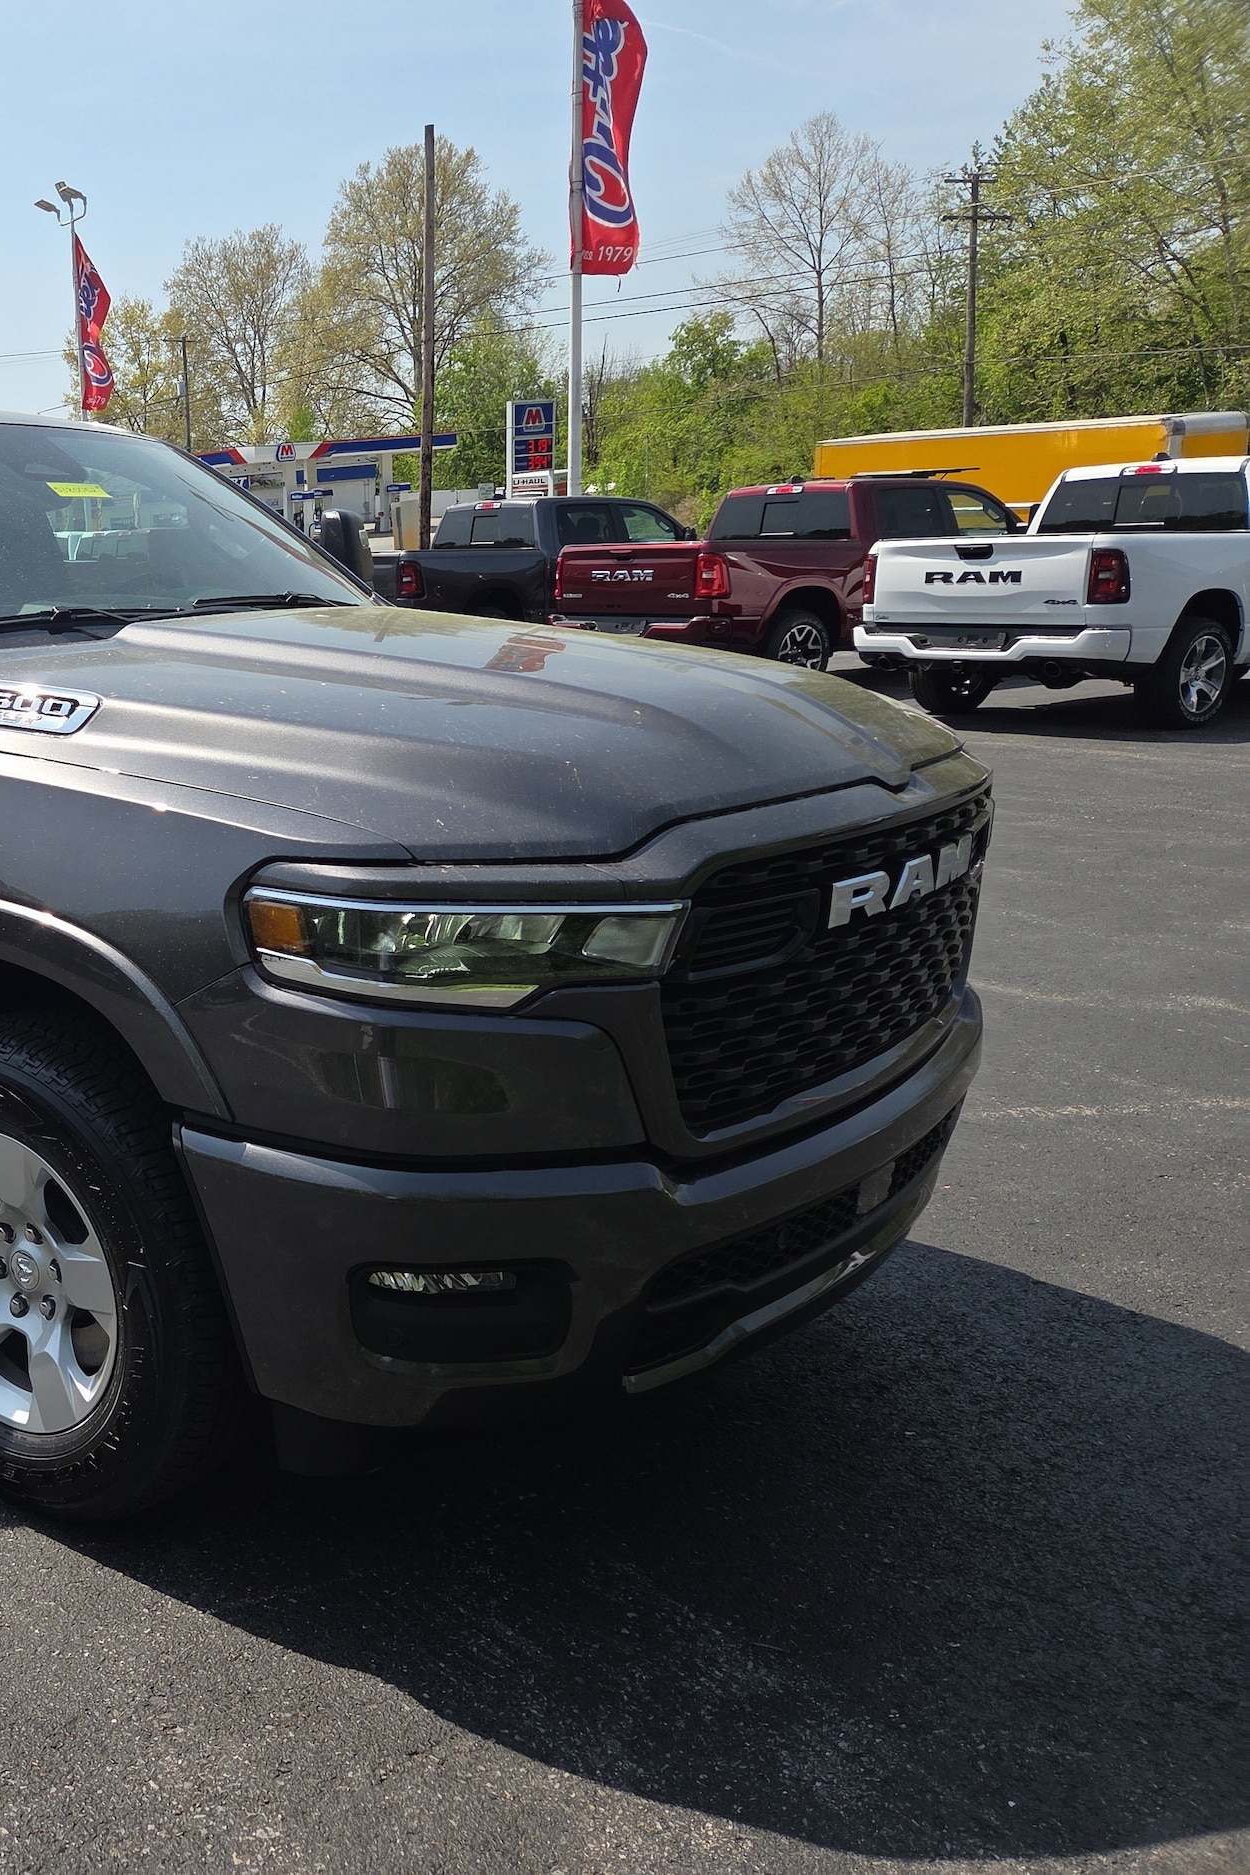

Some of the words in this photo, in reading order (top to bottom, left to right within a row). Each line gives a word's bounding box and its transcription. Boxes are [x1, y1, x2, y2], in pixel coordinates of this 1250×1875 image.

[598, 245, 634, 263] 1979
[513, 478, 546, 486] U-HAUL
[591, 569, 655, 582] RAM
[924, 570, 1023, 585] RAM
[827, 832, 973, 930] RAM
